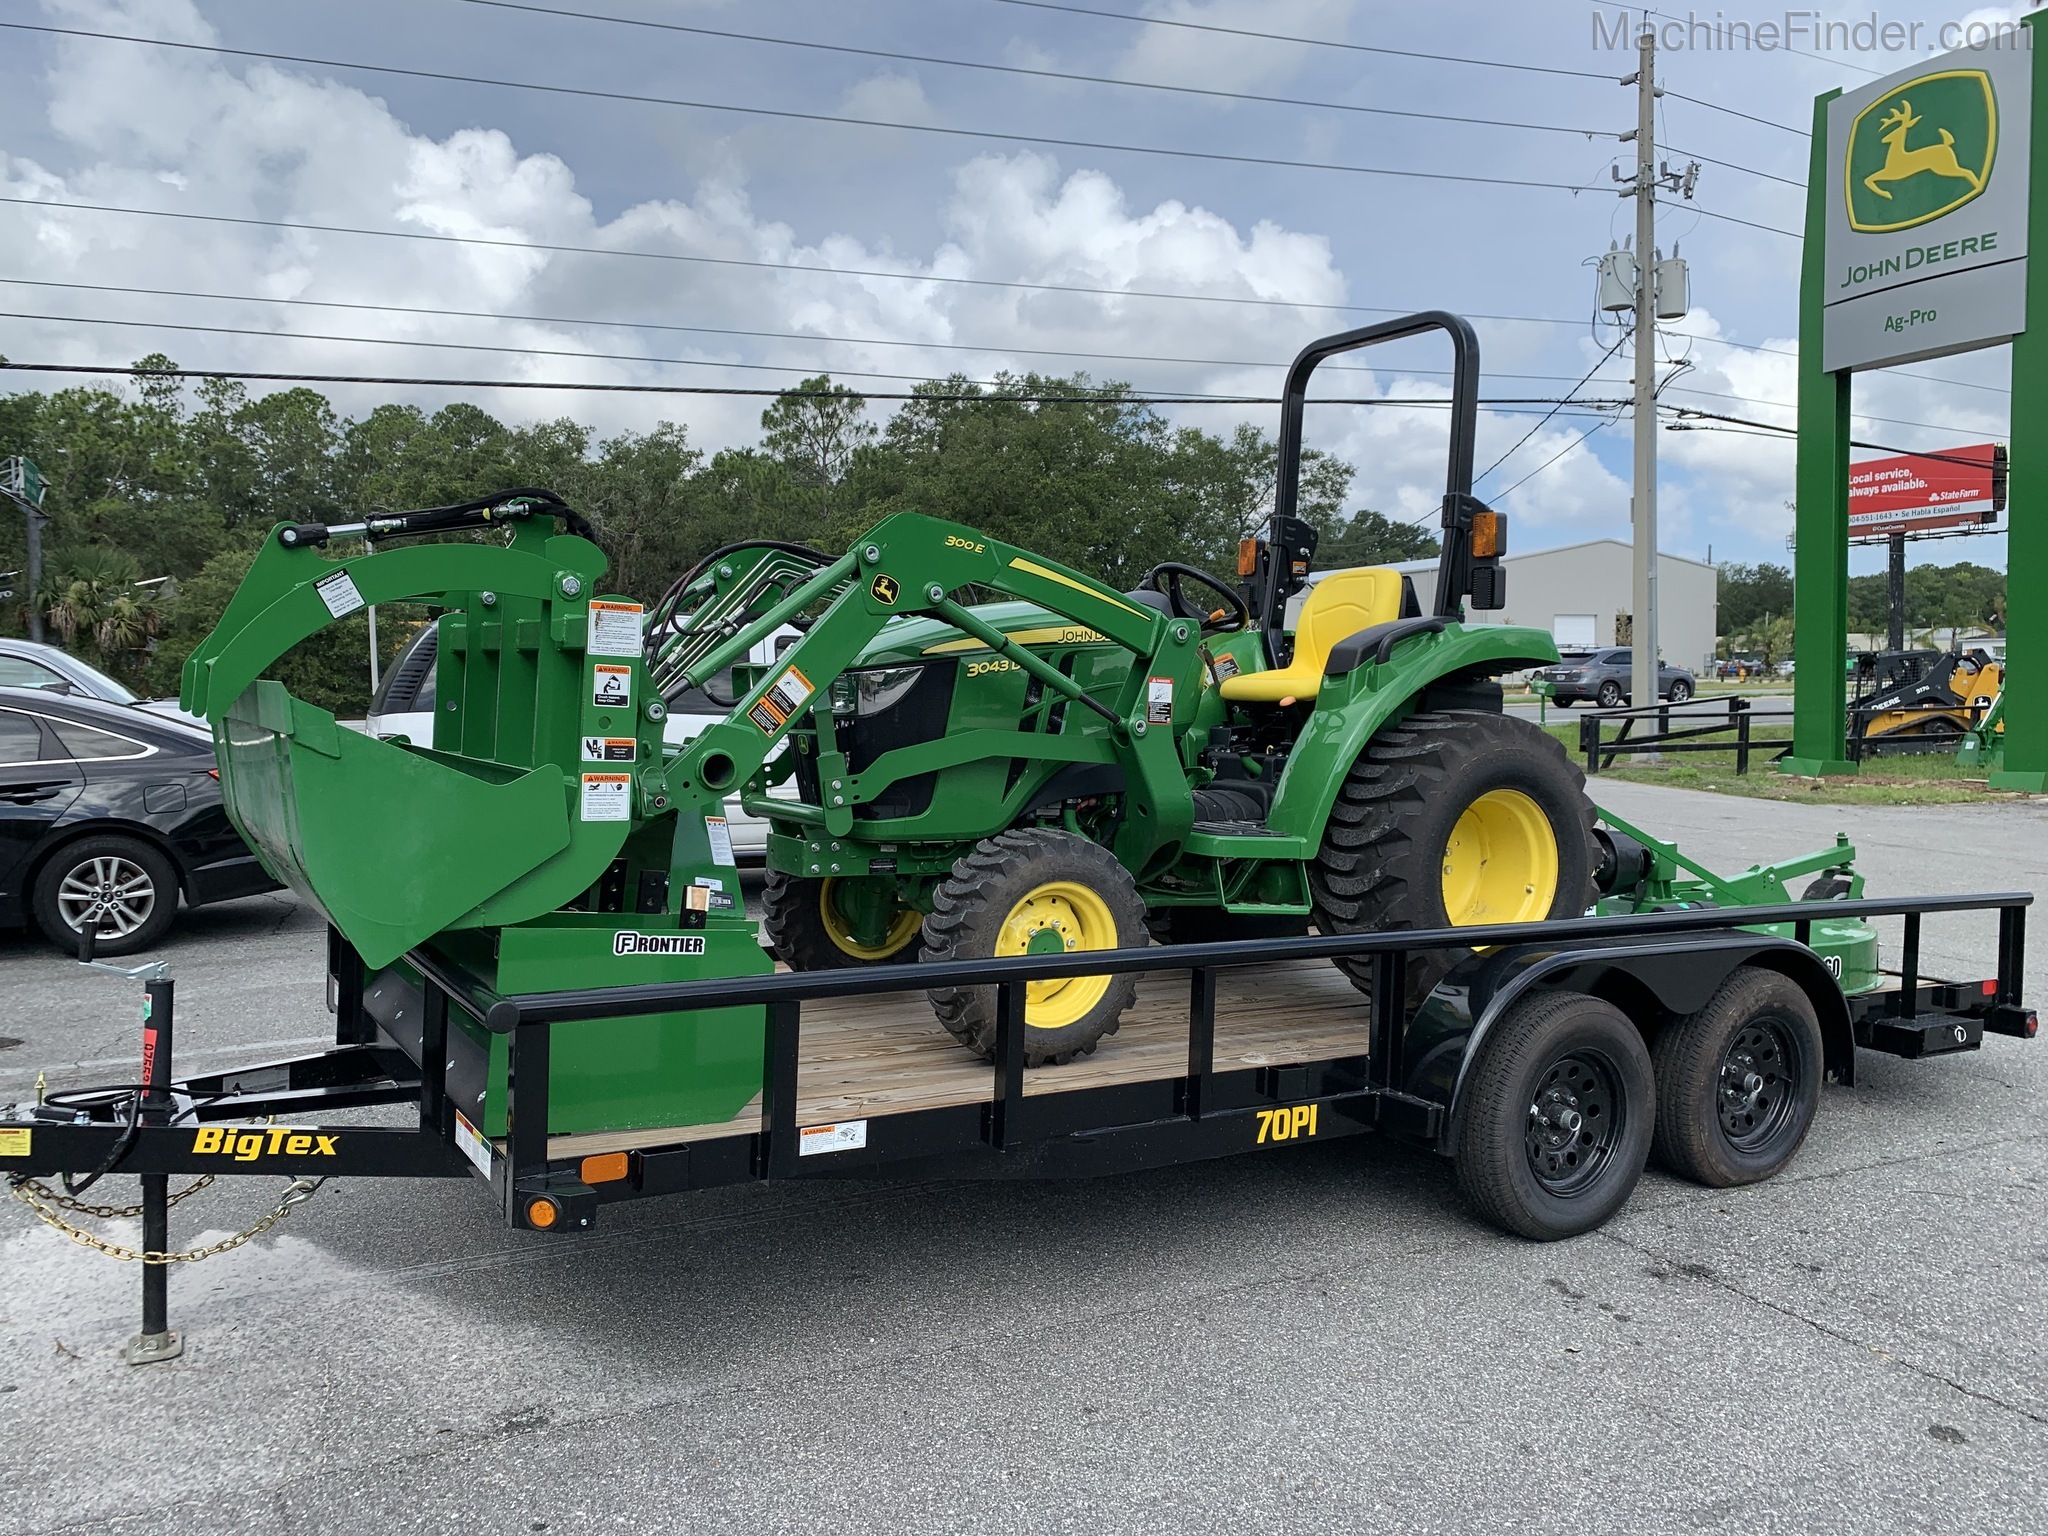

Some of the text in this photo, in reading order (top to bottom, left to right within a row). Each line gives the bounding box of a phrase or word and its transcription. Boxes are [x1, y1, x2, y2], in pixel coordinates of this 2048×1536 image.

[1841, 231, 1998, 288] JOHN DEERE
[1884, 309, 1937, 332] Ag-Pro
[1849, 467, 1913, 485] Local service,
[1849, 478, 1928, 497] always available.
[1911, 508, 1931, 517] Habla
[1933, 505, 1961, 514] Español
[316, 571, 345, 587] IMPORTANT
[1057, 630, 1093, 644] JOHN
[966, 660, 1009, 678] 3043
[1871, 696, 1901, 710] DEERE
[615, 932, 704, 954] FRONTIER
[808, 1126, 831, 1135] WARNING
[1256, 1104, 1318, 1144] 70PI
